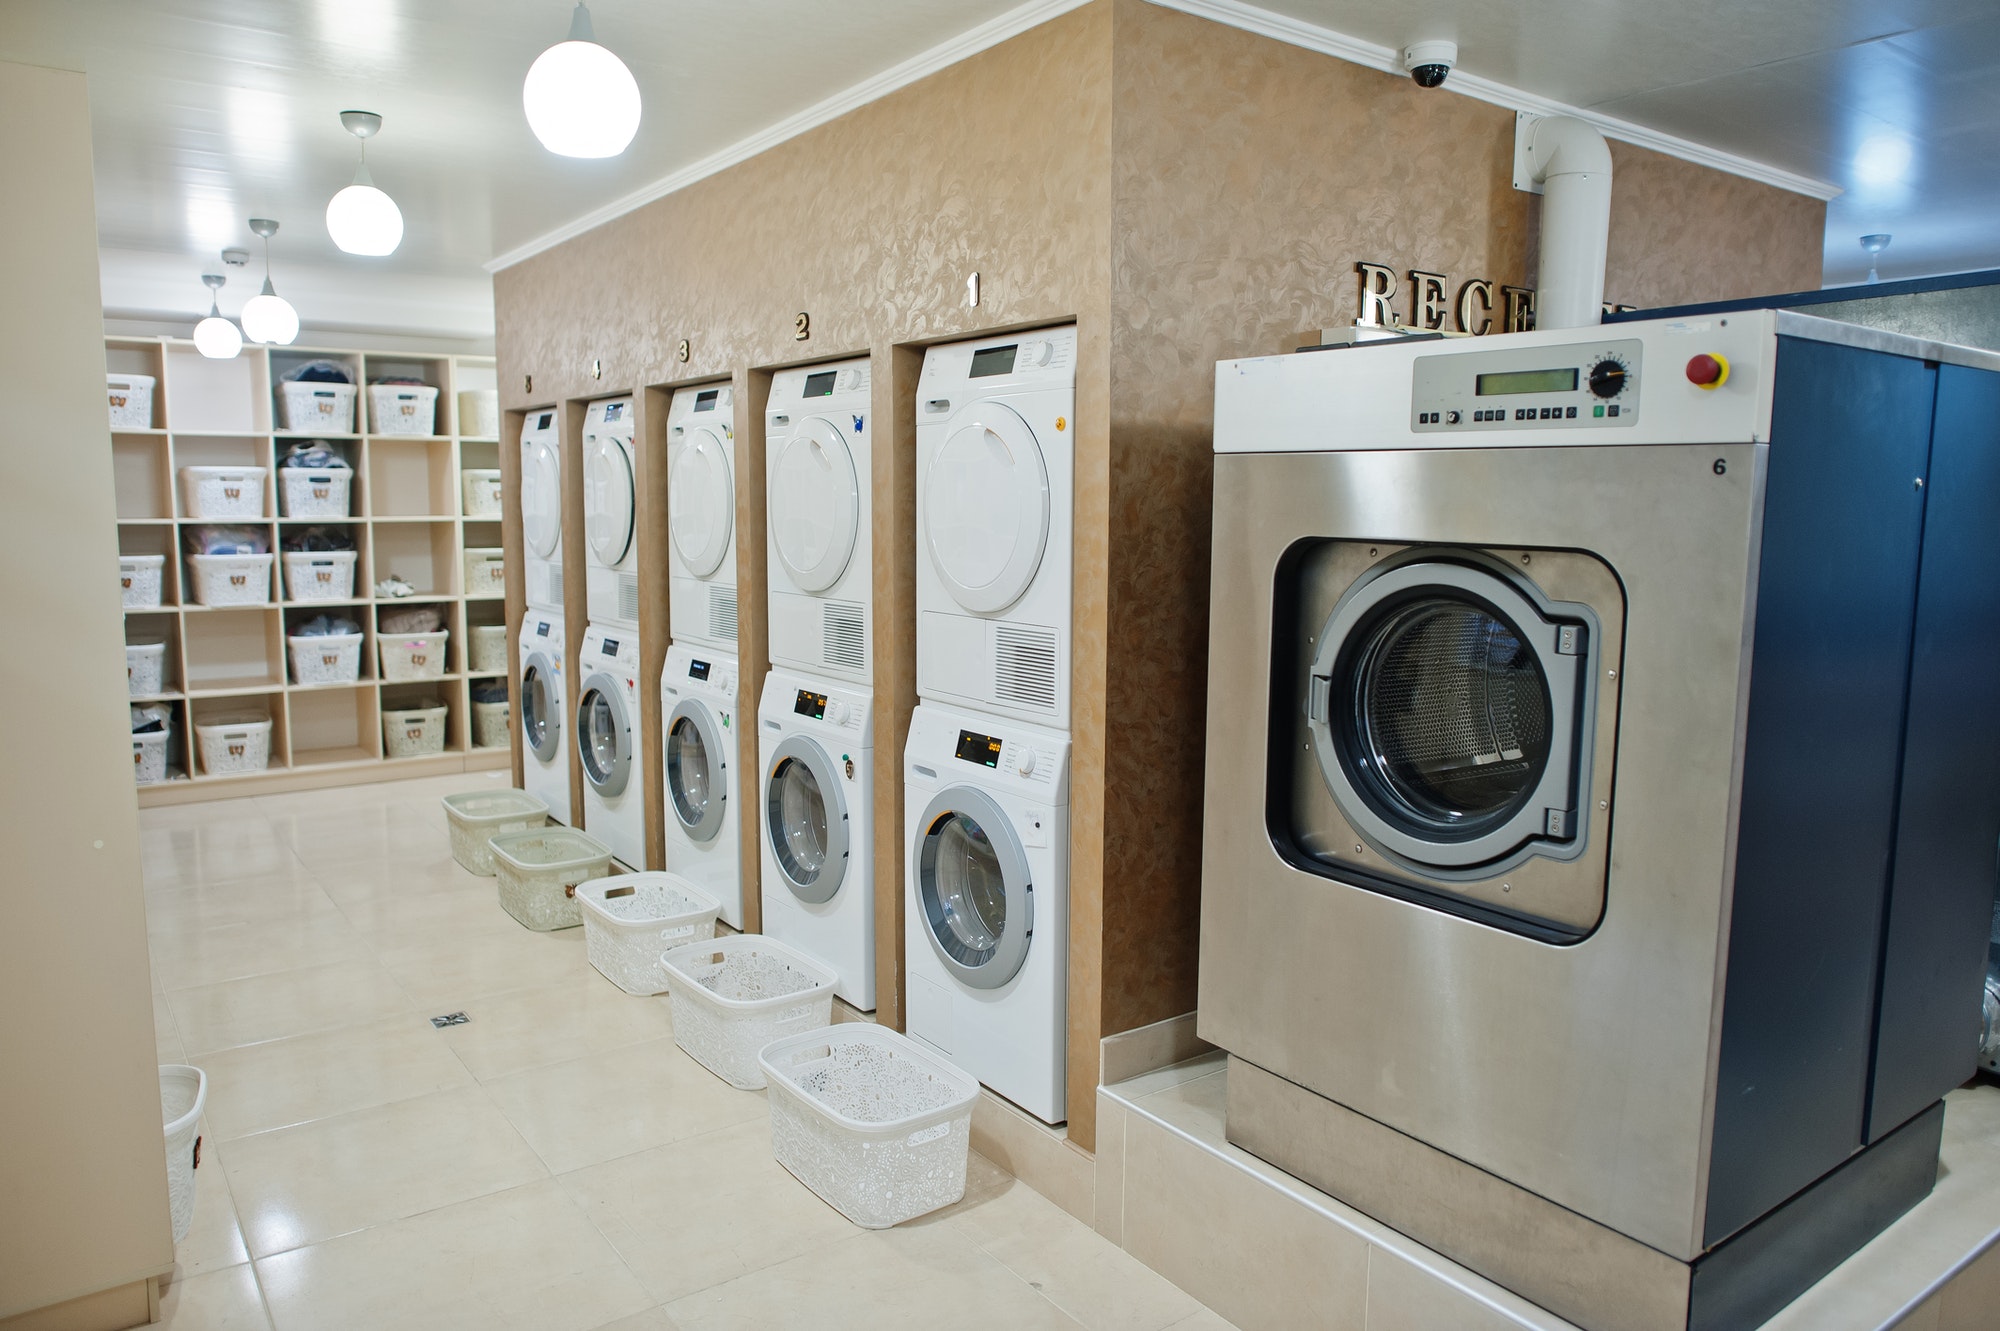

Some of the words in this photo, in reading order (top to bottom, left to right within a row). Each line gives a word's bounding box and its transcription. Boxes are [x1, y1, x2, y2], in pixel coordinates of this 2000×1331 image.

[966, 271, 980, 308] 1
[1356, 261, 1637, 336] RECE
[795, 312, 809, 341] 2
[679, 339, 690, 362] 3
[591, 359, 601, 380] 4
[1713, 458, 1727, 476] 6
